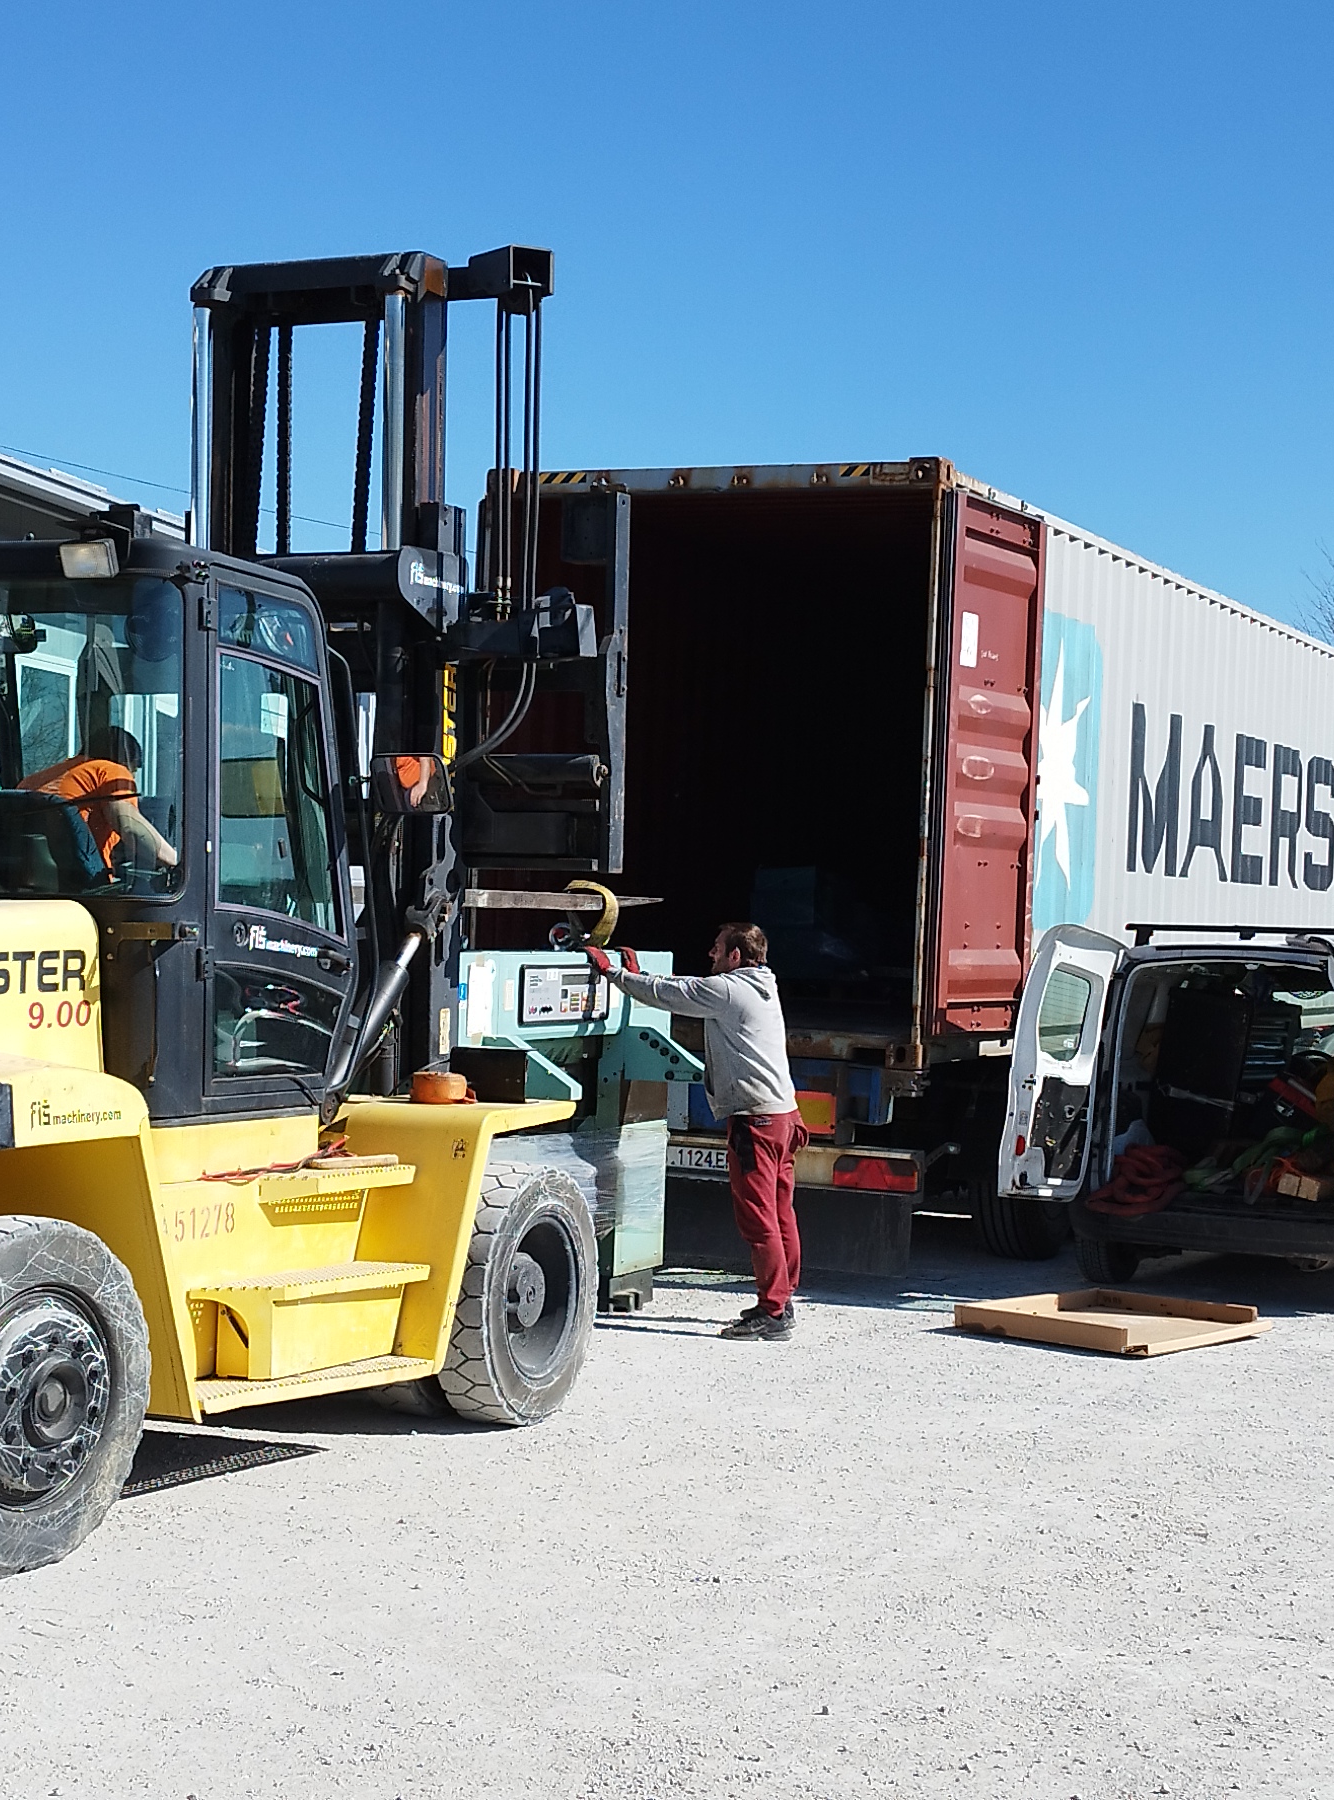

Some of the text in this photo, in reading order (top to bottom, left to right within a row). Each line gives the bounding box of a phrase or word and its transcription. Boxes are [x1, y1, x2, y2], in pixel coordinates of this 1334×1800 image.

[28, 1000, 92, 1030] 9.00
[53, 1109, 122, 1126] machinery.com
[174, 1201, 235, 1243] 51278
